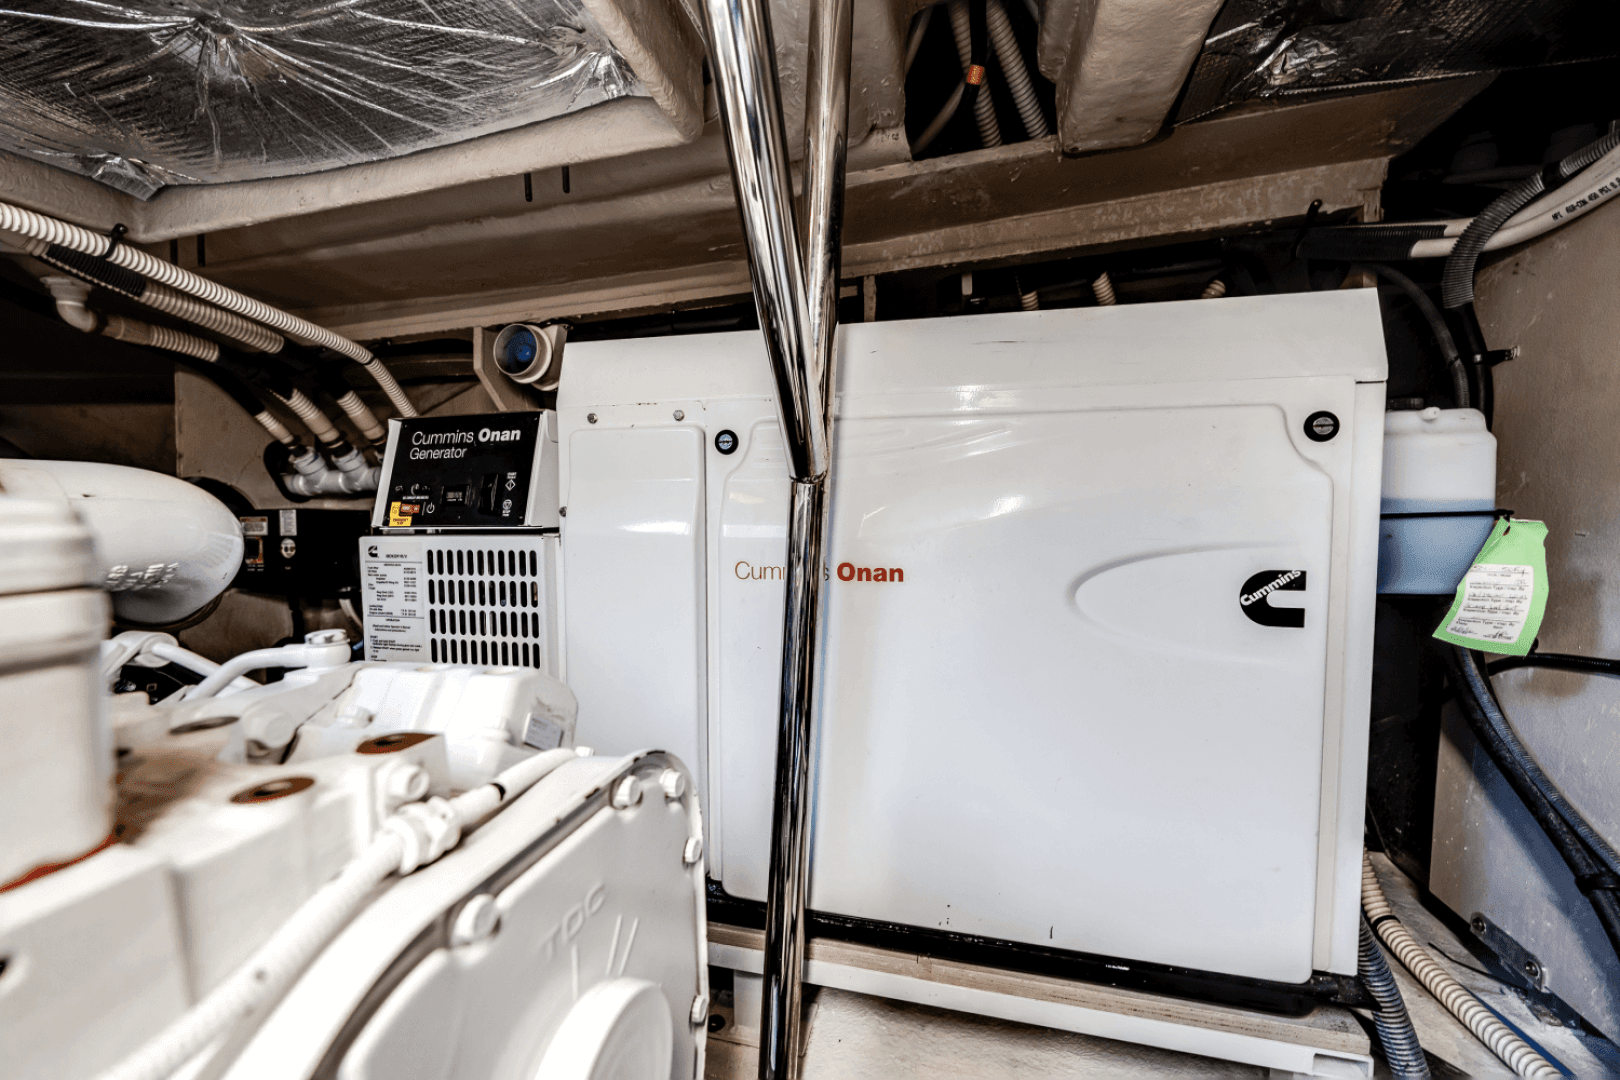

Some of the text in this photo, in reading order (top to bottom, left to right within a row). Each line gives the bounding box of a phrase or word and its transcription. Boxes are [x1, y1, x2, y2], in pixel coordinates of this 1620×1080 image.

[1598, 185, 1612, 195] PSI
[411, 427, 521, 446] Cummins Onan
[409, 447, 467, 460] Generator
[735, 560, 904, 582] Cums Onan
[1240, 569, 1302, 606] Cummins
